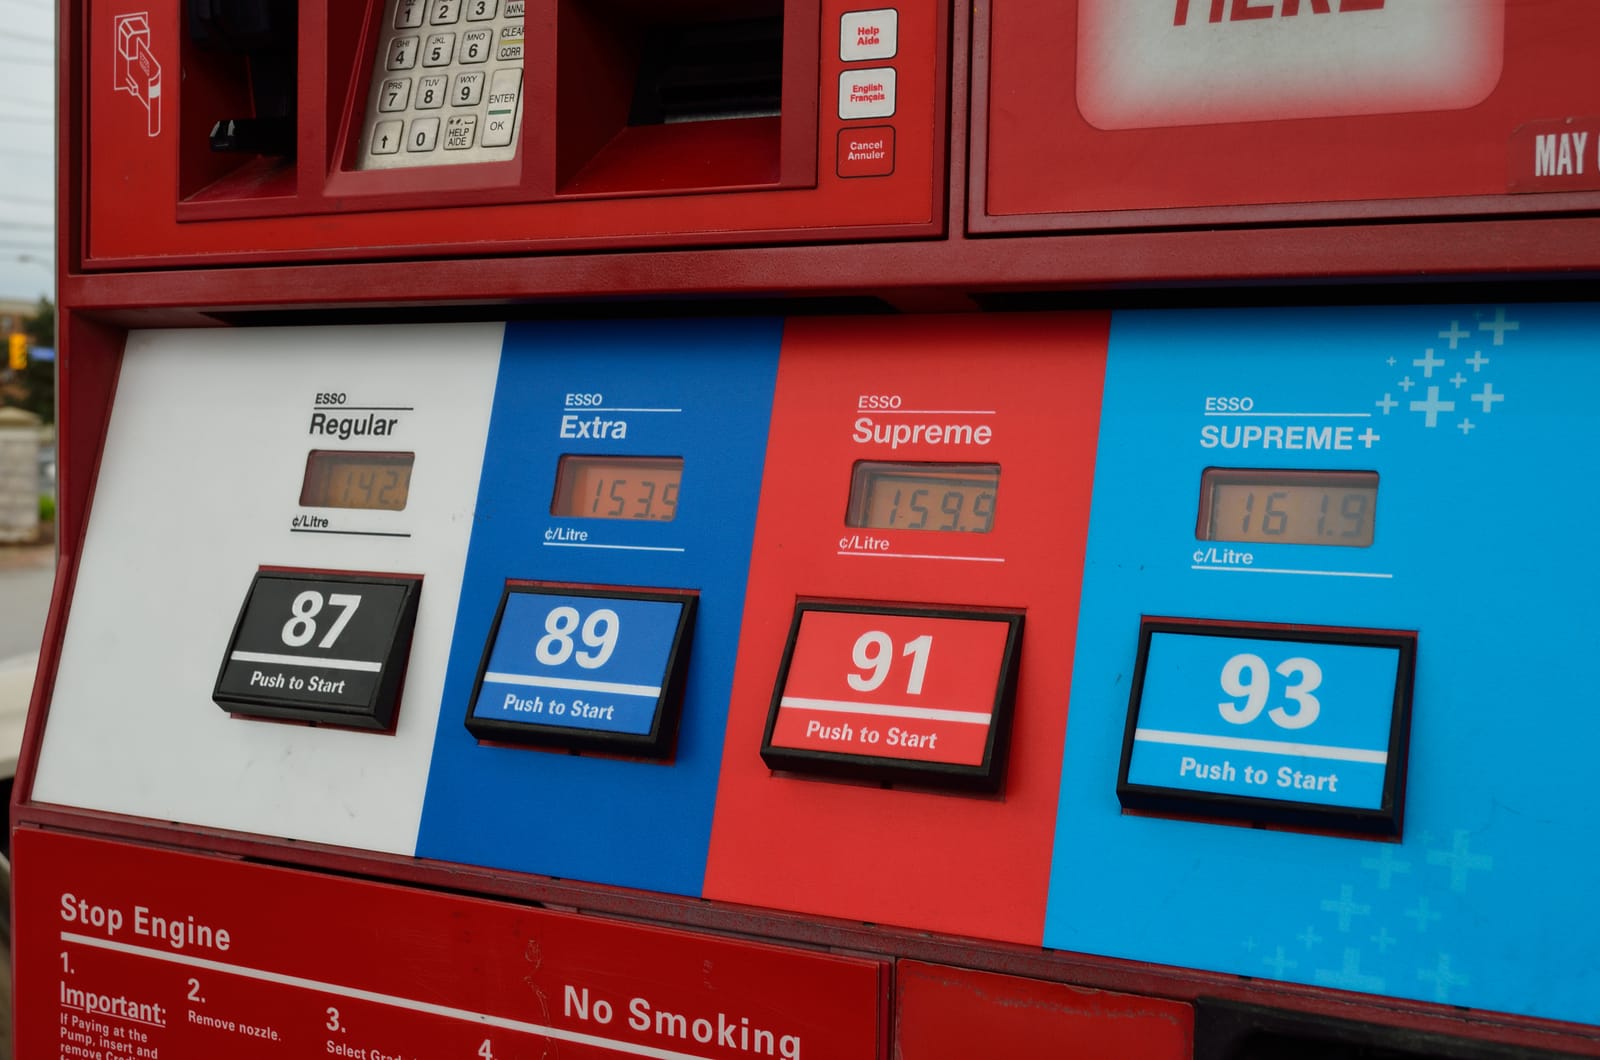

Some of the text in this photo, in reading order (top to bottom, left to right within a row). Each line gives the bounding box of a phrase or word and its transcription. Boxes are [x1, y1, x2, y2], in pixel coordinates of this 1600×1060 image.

[439, 5, 449, 19] 2
[475, 1, 485, 15] 3
[404, 9, 411, 23] 1
[467, 32, 486, 41] MNO
[857, 26, 880, 36] Help
[432, 36, 446, 45] JKL
[857, 36, 880, 46] Aide
[396, 51, 404, 64] 4
[432, 47, 442, 61] 5
[468, 43, 478, 58] 6
[500, 46, 521, 57] CORR
[388, 81, 403, 89] PRS
[425, 79, 440, 87] TUV
[460, 75, 477, 84] WXY
[461, 86, 471, 101] 9
[852, 83, 883, 94] English
[389, 93, 398, 106] 7
[424, 90, 434, 104] 8
[489, 93, 515, 104] ENTER
[850, 93, 885, 104] Français
[448, 128, 469, 137] HELP
[490, 121, 504, 131] OK
[416, 132, 425, 146] 0
[448, 137, 467, 146] AIDE
[850, 140, 883, 151] Cancel
[848, 151, 884, 161] Annuler
[1535, 131, 1588, 176] MAY
[315, 393, 346, 405] ESSO
[565, 393, 603, 407] ESSO
[857, 395, 901, 410] ESSO
[1205, 396, 1254, 412] ESSO
[309, 413, 398, 440] Regular
[560, 415, 628, 440] Extra
[852, 417, 992, 449] Supreme
[281, 590, 362, 649] 87
[535, 605, 620, 670] 89
[847, 630, 933, 695] 91
[250, 670, 345, 695] Push to Start
[1218, 652, 1323, 730] 93
[503, 693, 615, 721] Push to Start
[806, 719, 938, 751] Push to Start
[1179, 756, 1339, 793] Push to Start
[60, 893, 231, 951] Stop Engine
[60, 952, 75, 974] 1.
[187, 978, 206, 1003] 2.
[60, 981, 167, 1026] Important:
[60, 1012, 148, 1042] If Paying at the
[188, 1010, 282, 1042] Remove nozzle.
[326, 1007, 346, 1033] 3.
[564, 985, 801, 1060] No Smoking
[60, 1027, 96, 1047] Pump,
[99, 1035, 133, 1054] insert
[136, 1047, 158, 1060] and
[326, 1040, 366, 1060] Select
[60, 1043, 102, 1060] remove
